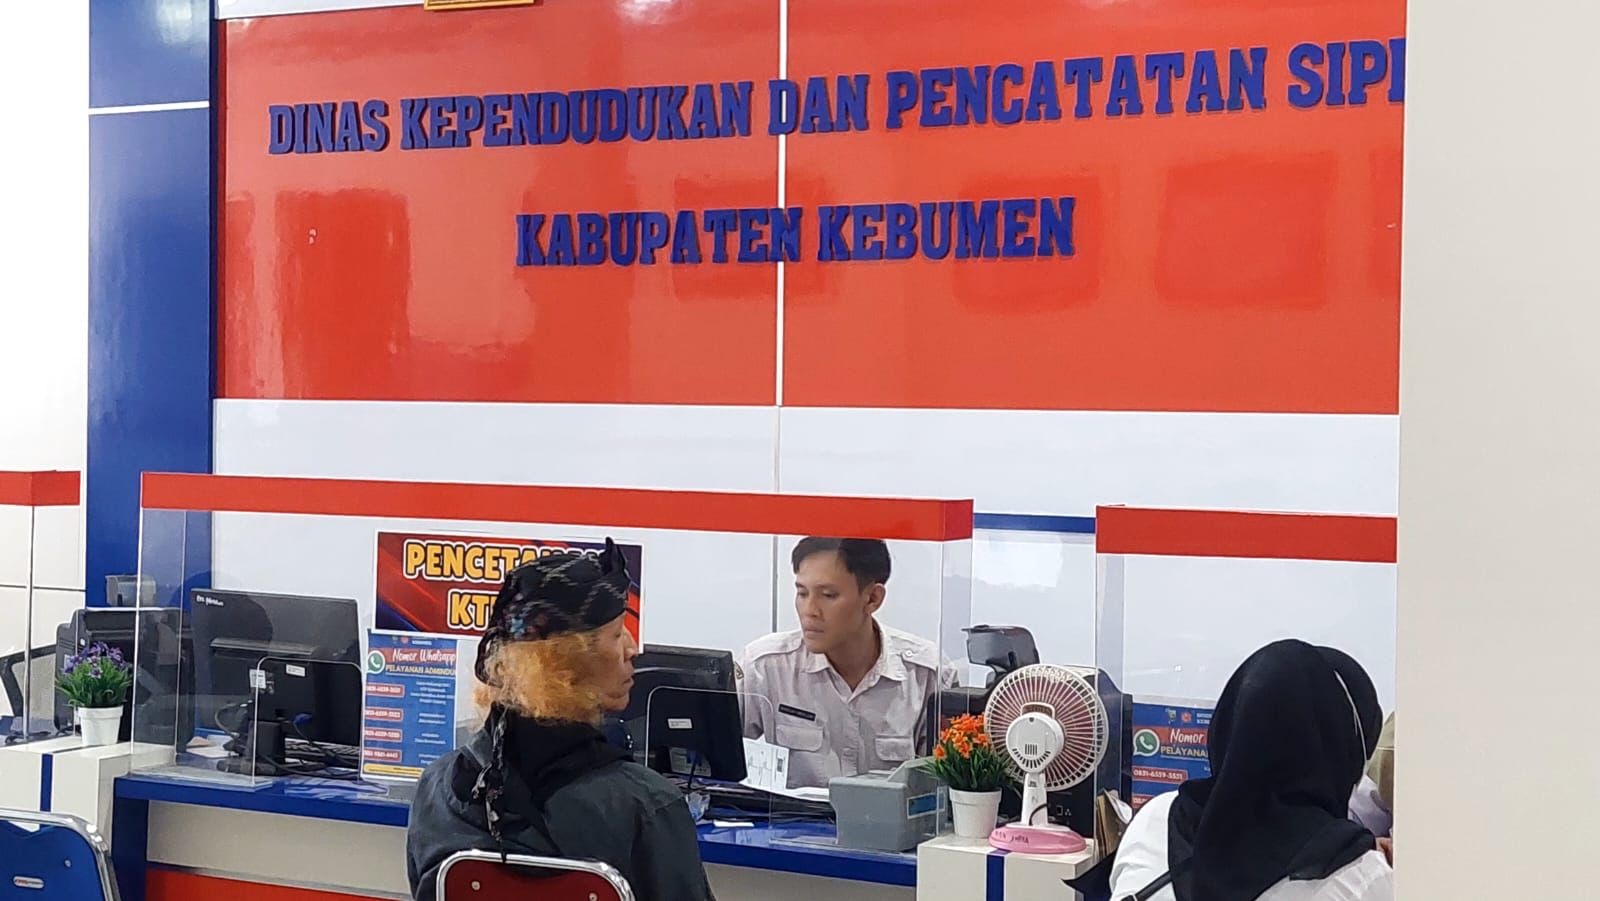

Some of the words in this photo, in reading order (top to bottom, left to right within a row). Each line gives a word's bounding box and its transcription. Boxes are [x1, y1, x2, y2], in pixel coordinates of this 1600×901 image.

[268, 100, 390, 154] DINAS
[400, 81, 754, 150] KEPENDUDUKAN
[768, 74, 869, 136] DAN
[886, 47, 1267, 129] PENCATATAN
[516, 205, 803, 266] KABUPATEN
[817, 197, 1077, 261] KEBUMEN
[449, 591, 497, 630] KT
[385, 664, 424, 674] PELAYANAN
[1170, 727, 1204, 744] Nomor
[1160, 745, 1208, 757] PELAYANA
